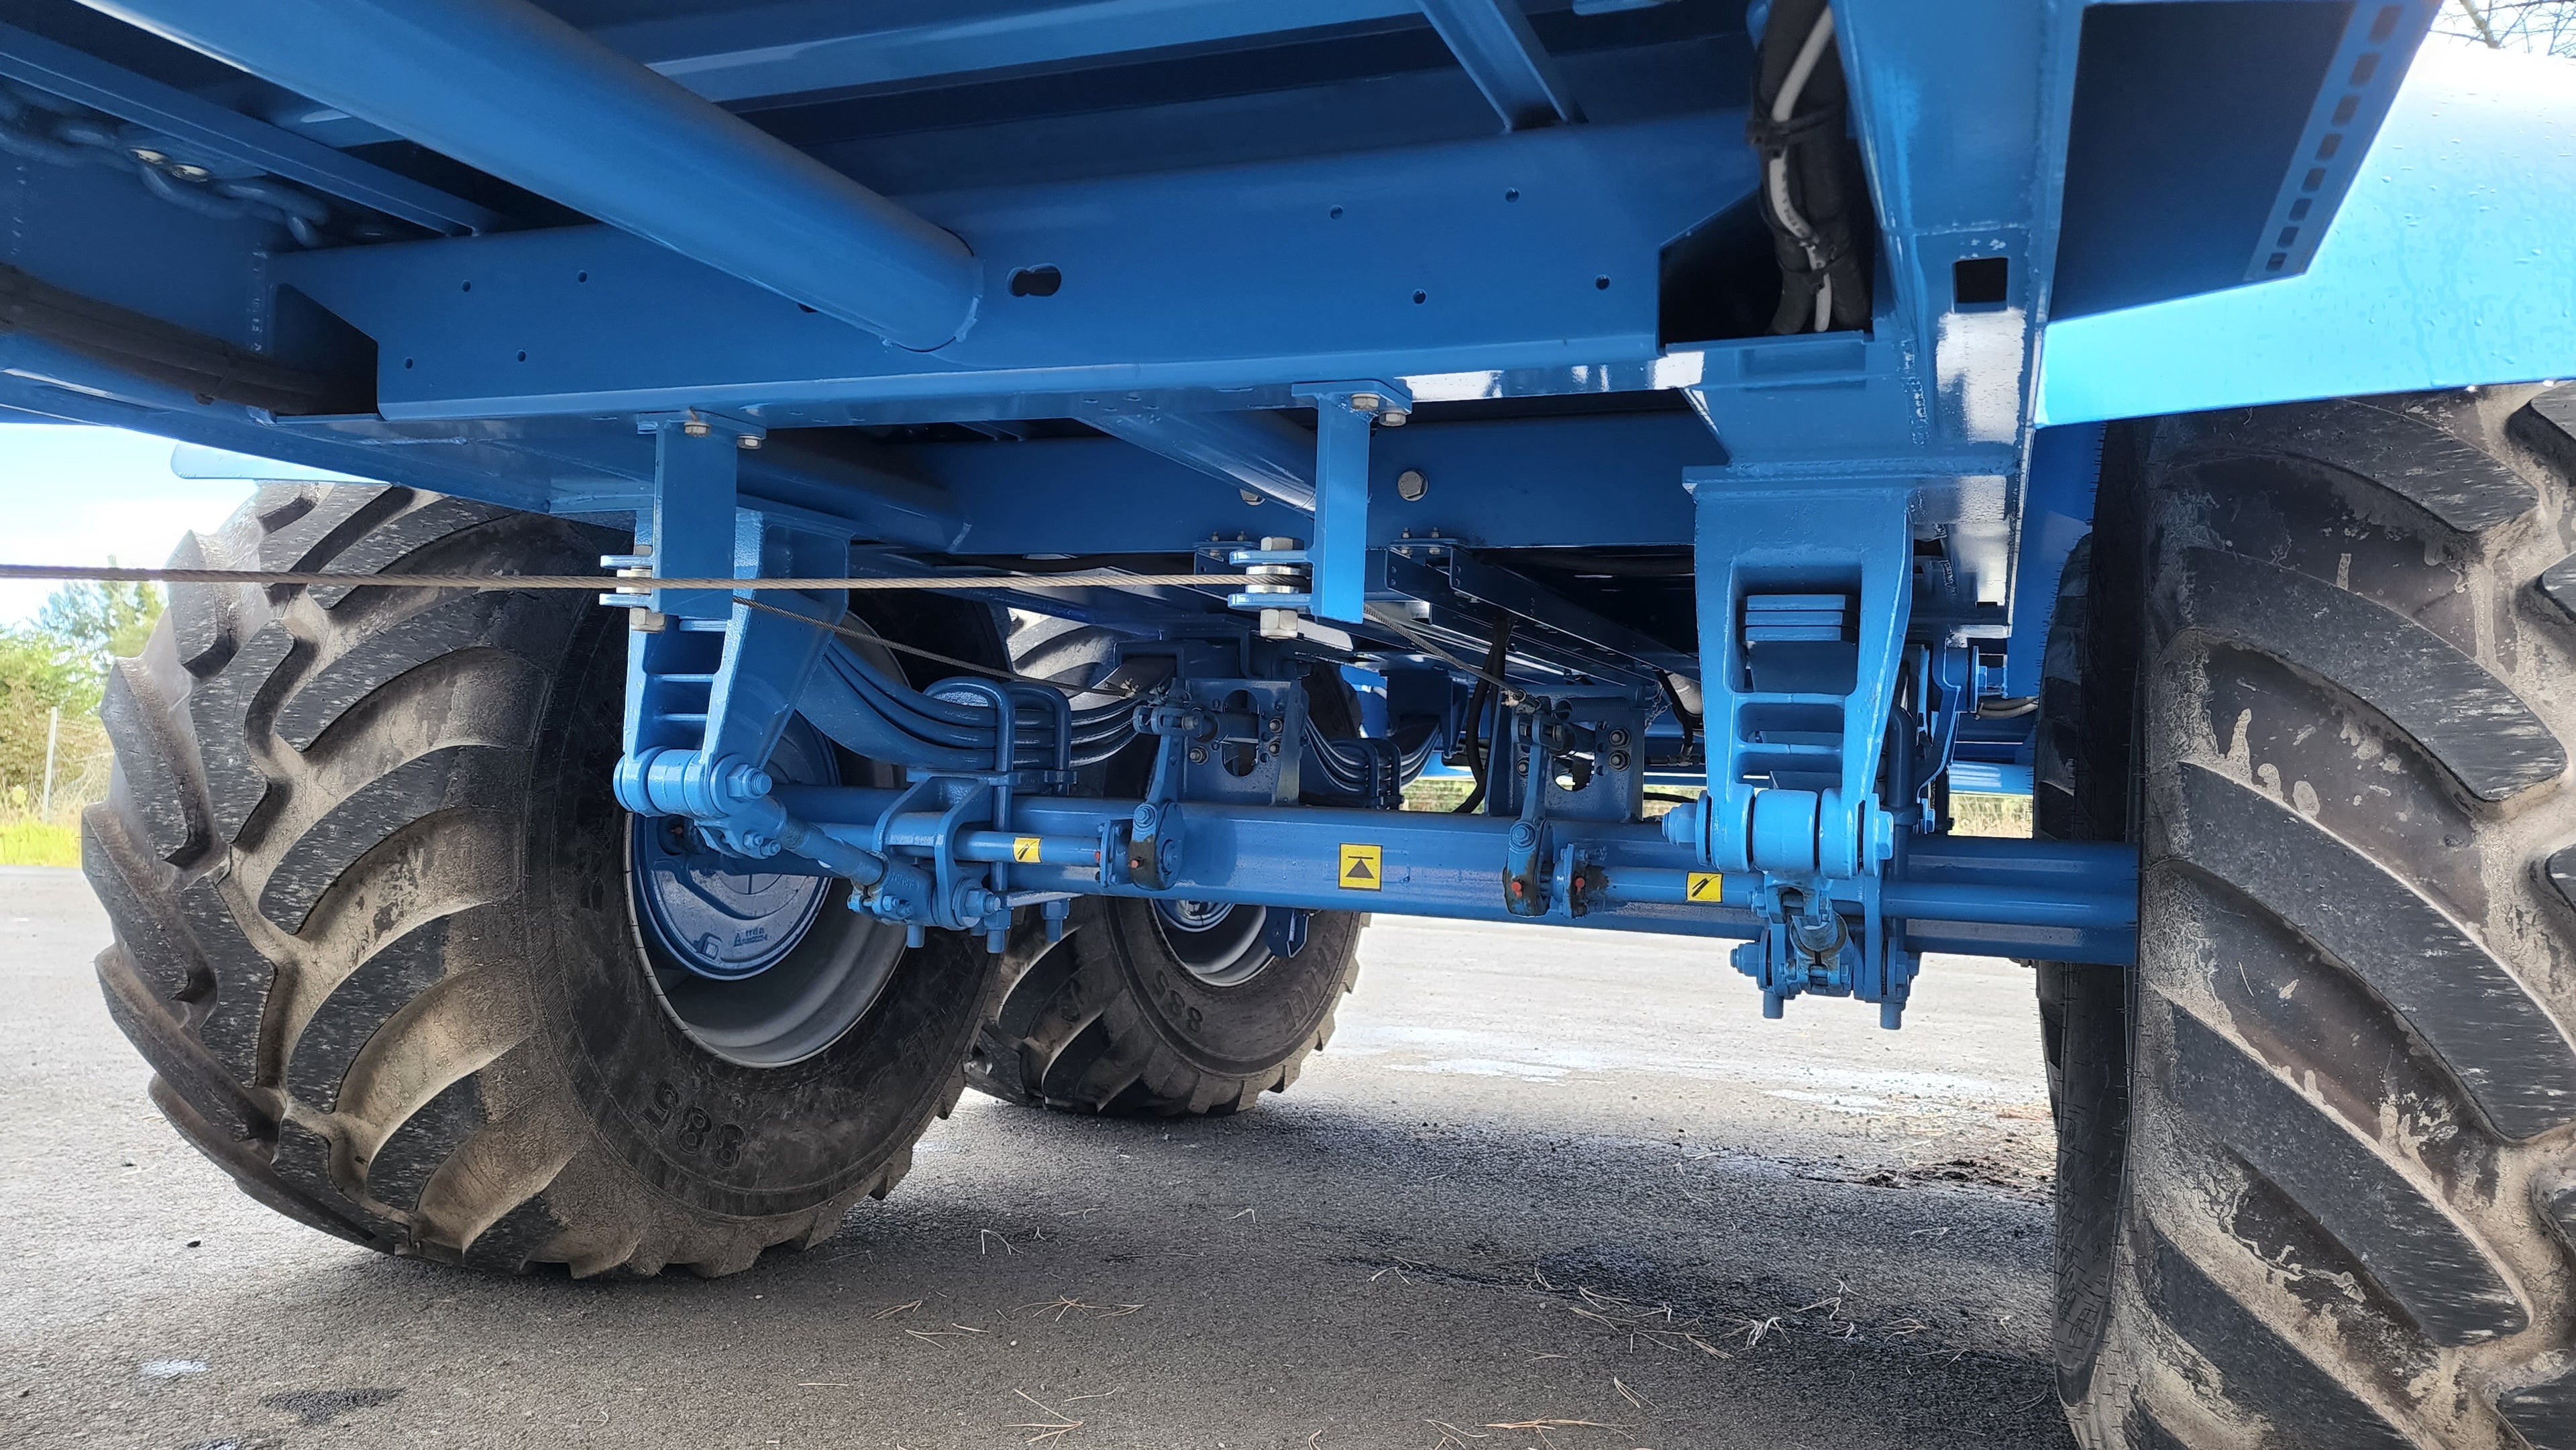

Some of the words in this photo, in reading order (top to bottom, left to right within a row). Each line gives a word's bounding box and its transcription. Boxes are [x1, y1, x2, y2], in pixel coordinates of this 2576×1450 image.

[1152, 970, 1204, 1034] 885
[1277, 916, 1347, 1036] LIANCE
[642, 1078, 747, 1170] 885
